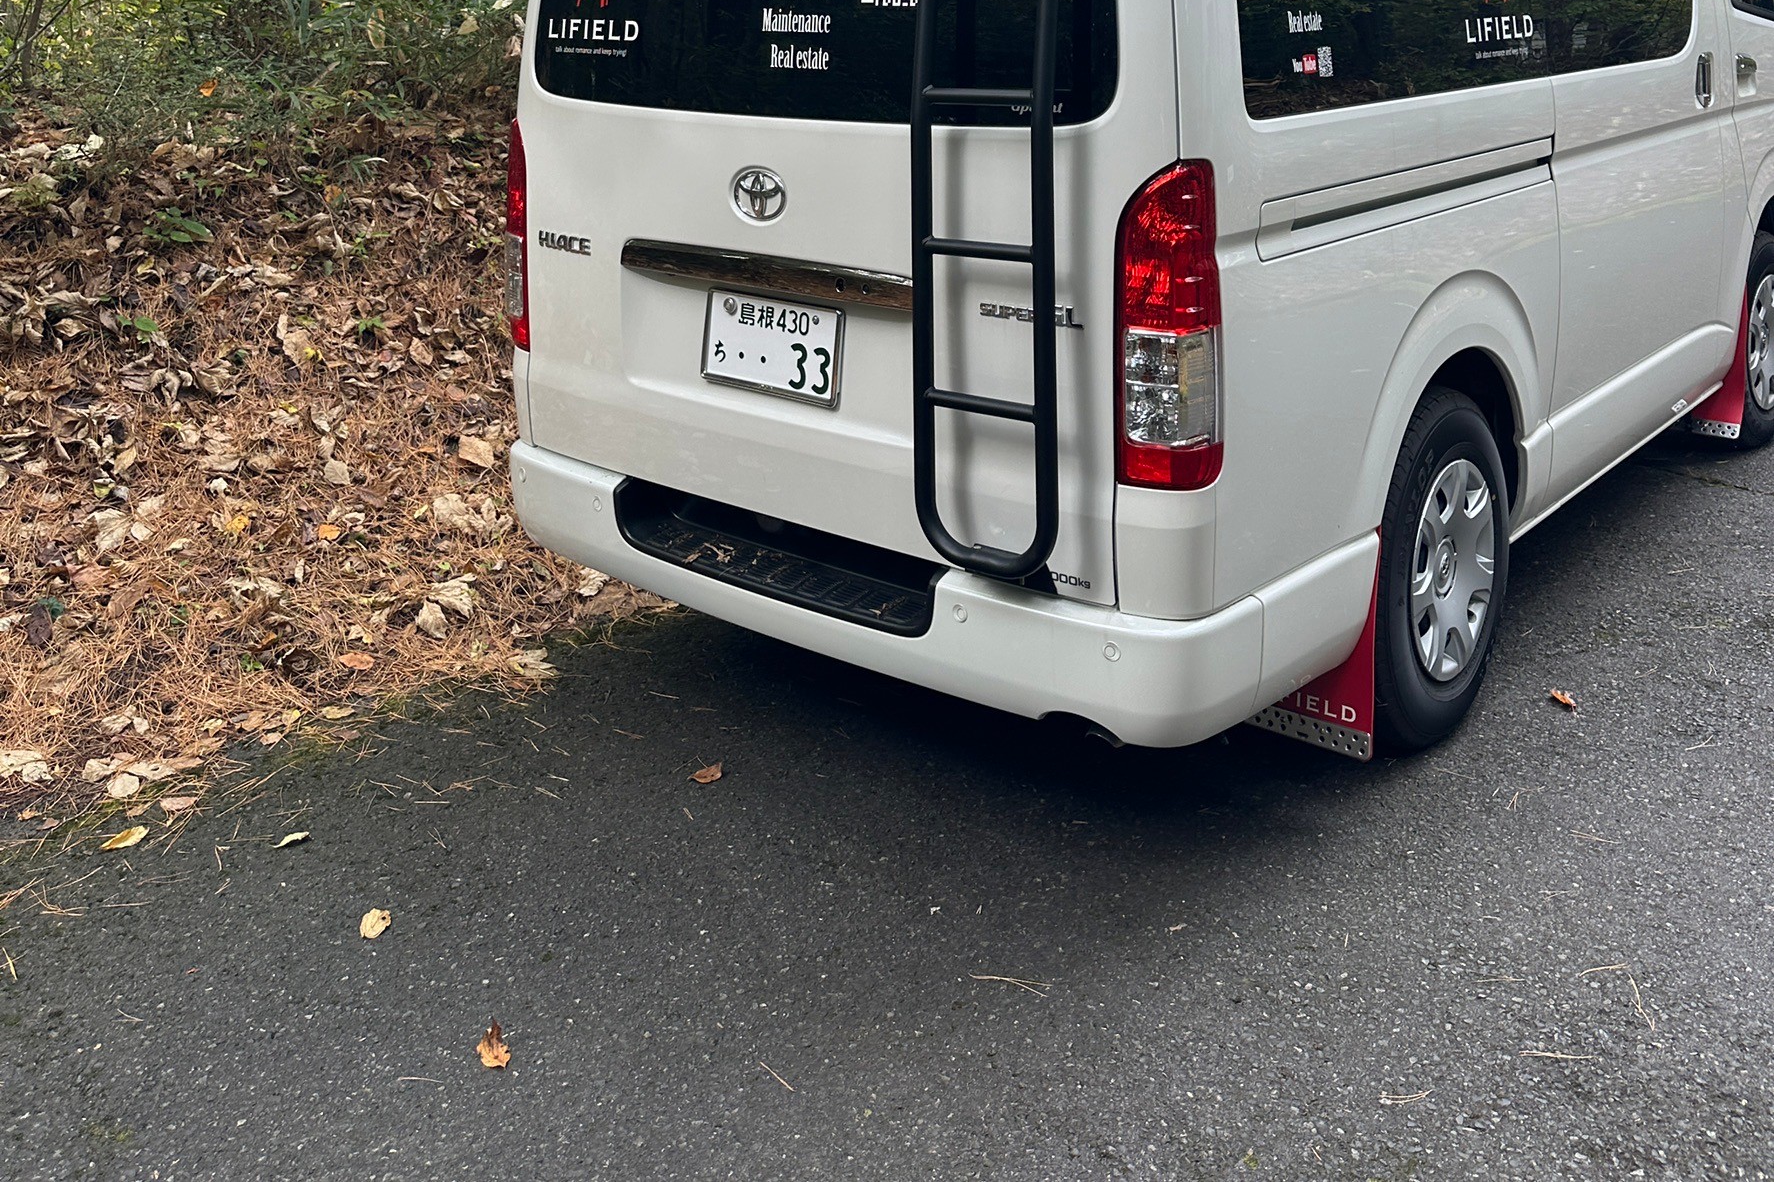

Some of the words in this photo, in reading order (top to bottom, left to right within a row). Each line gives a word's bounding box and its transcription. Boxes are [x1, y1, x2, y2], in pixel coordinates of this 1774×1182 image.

[548, 18, 639, 41] LIFIELD
[762, 8, 831, 34] Maintenance
[1287, 10, 1304, 33] Real
[1304, 11, 1323, 31] estate
[1465, 14, 1534, 43] LIFIELD
[770, 43, 795, 70] Real
[796, 46, 830, 71] estate
[538, 229, 592, 257] HIACE
[1049, 571, 1091, 590] 000kg
[1282, 692, 1357, 723] IELD
